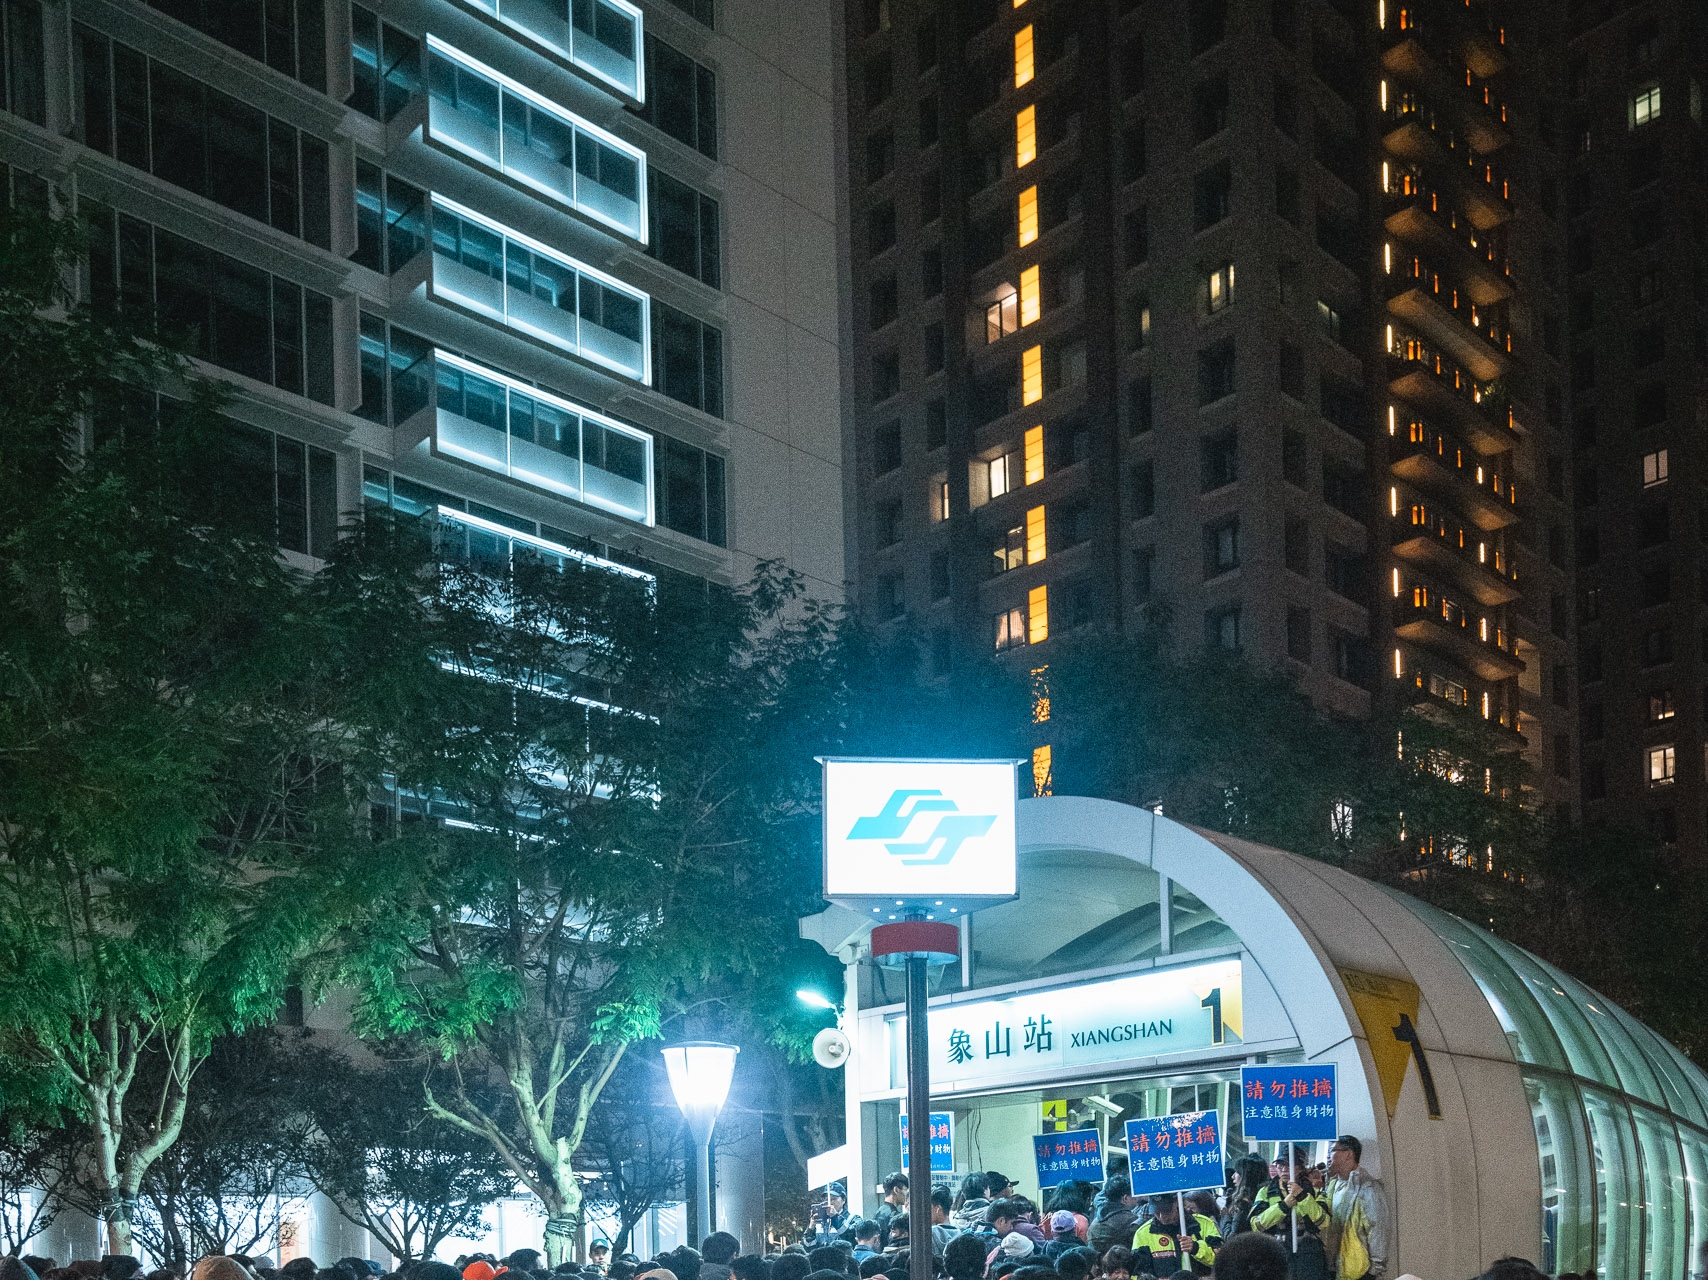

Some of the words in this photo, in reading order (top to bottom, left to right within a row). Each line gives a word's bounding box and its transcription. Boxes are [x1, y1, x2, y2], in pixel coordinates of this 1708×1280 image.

[1201, 987, 1225, 1046] 1
[946, 1013, 1053, 1065] 象山站
[1070, 1018, 1173, 1049] XIANGSHAN
[1245, 1078, 1332, 1100] 請勿推擠
[1245, 1104, 1335, 1119] 注意隨身財物
[1037, 1138, 1099, 1158] 請勿推擠
[1130, 1124, 1218, 1153] 請勿推擠
[1038, 1157, 1102, 1172] 注意隨身財物
[1132, 1150, 1220, 1173] 注意隨身財物
